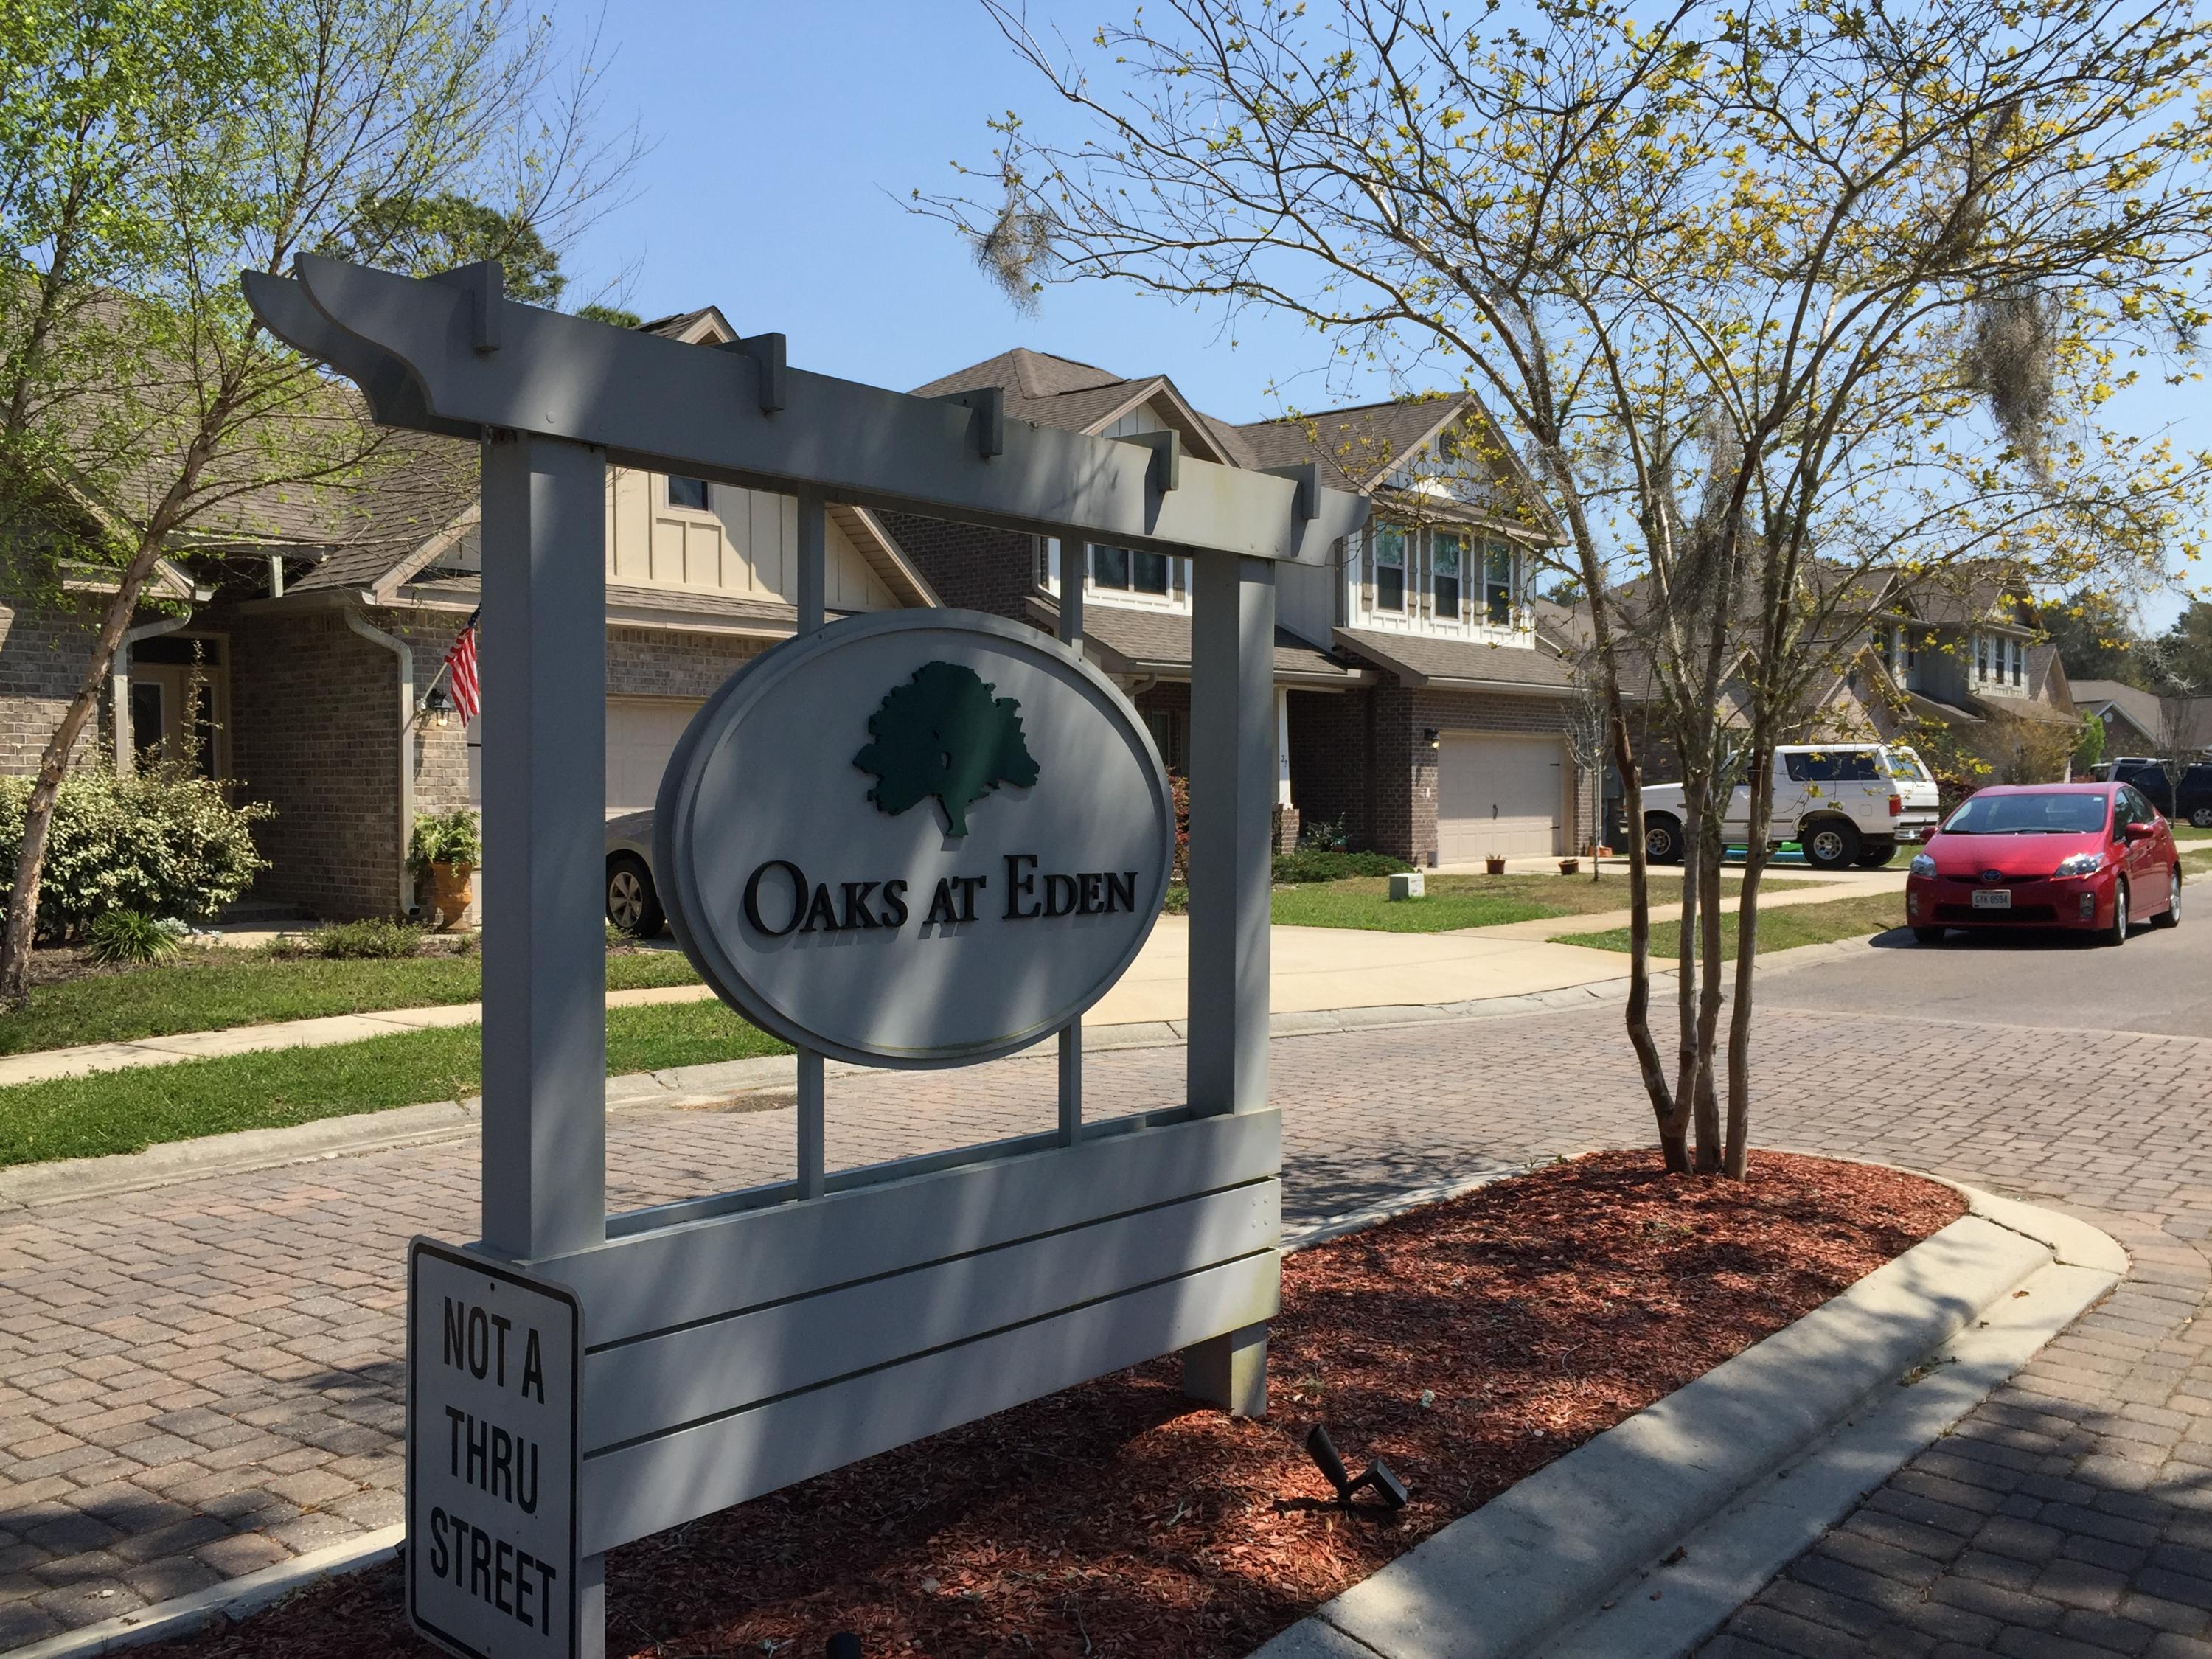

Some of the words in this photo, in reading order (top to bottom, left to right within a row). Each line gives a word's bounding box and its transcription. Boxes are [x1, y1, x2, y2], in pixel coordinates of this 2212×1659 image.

[444, 1296, 511, 1388] NOT
[521, 1327, 545, 1405] A
[445, 1404, 538, 1514] THRU
[430, 1506, 556, 1637] STREET
